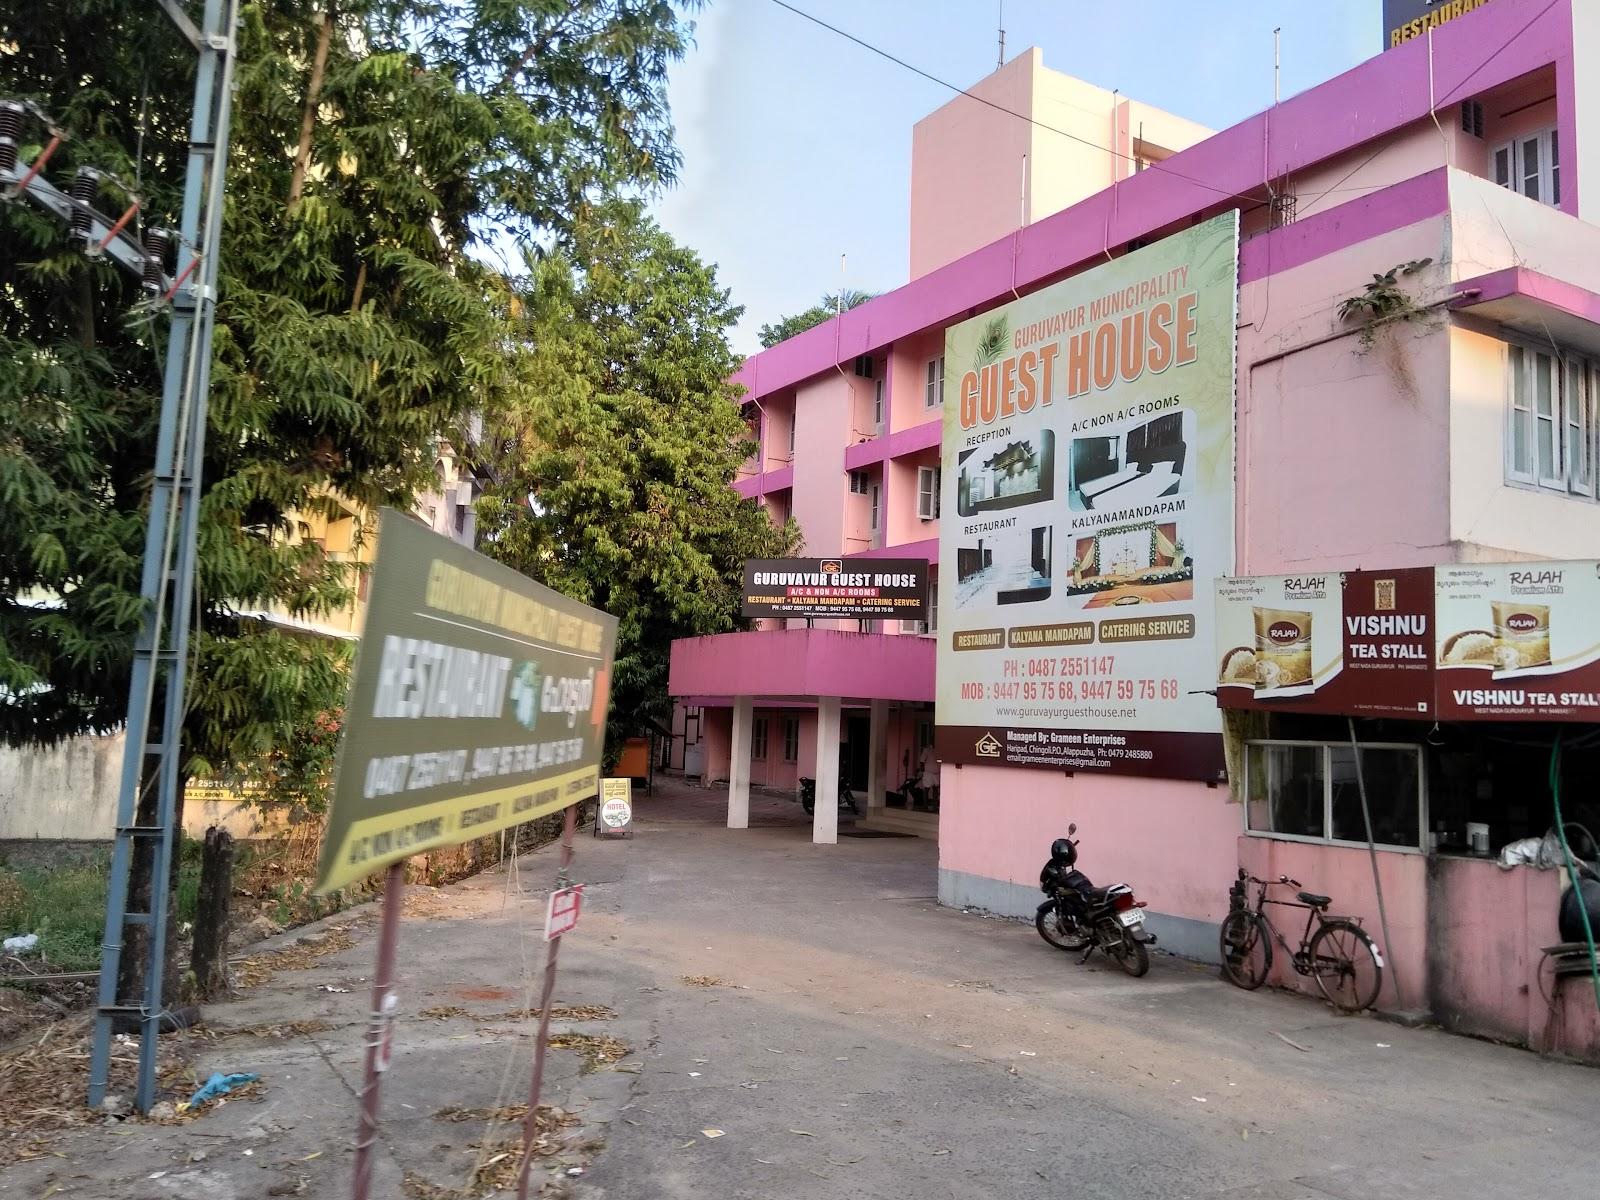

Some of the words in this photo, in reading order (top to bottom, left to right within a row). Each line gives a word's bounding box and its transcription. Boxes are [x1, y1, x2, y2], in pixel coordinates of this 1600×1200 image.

[1014, 305, 1085, 350] GURUVAYUR
[1090, 264, 1189, 321] MUNICIPALITY
[959, 342, 1059, 431] GUEST
[1067, 290, 1198, 399] HOUSE
[1072, 419, 1088, 433] A/C
[1091, 412, 1114, 428] NON
[1117, 406, 1136, 421] A/C
[1139, 395, 1180, 415] ROOMS
[966, 426, 1012, 447] RECEPTION
[1072, 500, 1186, 529] KALYANAMANDAPAM
[964, 517, 1017, 535] RESTAURANT
[753, 572, 828, 587] GURUVAYUR
[831, 573, 871, 587] GUEST
[874, 574, 916, 588] HOUSE
[1284, 577, 1325, 590] RAJAH
[1509, 570, 1562, 585] RAJAH
[848, 588, 876, 596] ROOMS
[1511, 585, 1545, 595] Premium
[747, 596, 786, 604] RESTAURANT
[820, 597, 856, 606] MANDAPAM
[862, 598, 893, 606] CATERING
[893, 599, 921, 607] SERVICE
[1101, 622, 1146, 639] CATERING
[1148, 619, 1190, 635] SERVICE
[1346, 615, 1426, 635] VISHNU
[1509, 619, 1536, 628] RAJAH
[958, 632, 1002, 647] RESTAURANT
[1011, 630, 1043, 644] KALYANA
[1045, 626, 1092, 642] MANDAPAM
[1270, 629, 1298, 638] RAJAH
[1350, 644, 1378, 658] TEA
[1381, 644, 1427, 659] STALL
[1004, 660, 1018, 677] PH
[1028, 659, 1056, 676] 0487
[1061, 655, 1115, 676] 2551147
[961, 682, 984, 700] MOB
[993, 682, 1020, 700] 9447
[1023, 682, 1037, 700] 95
[1041, 682, 1055, 700] 75
[1058, 681, 1077, 703] 68,
[1081, 680, 1112, 699] 9447
[1117, 680, 1134, 699] 59
[1139, 680, 1155, 699] 75
[1160, 679, 1178, 699] 68
[1453, 690, 1524, 705] VISHNU
[1527, 693, 1557, 705] TEA
[996, 706, 1137, 719] www.guruvayurguesthouse.net
[1007, 731, 1037, 743] Managed
[1038, 732, 1049, 744] By:
[1051, 732, 1082, 743] Grameen
[1083, 733, 1126, 747] Enterprises
[1108, 749, 1123, 758] 0479
